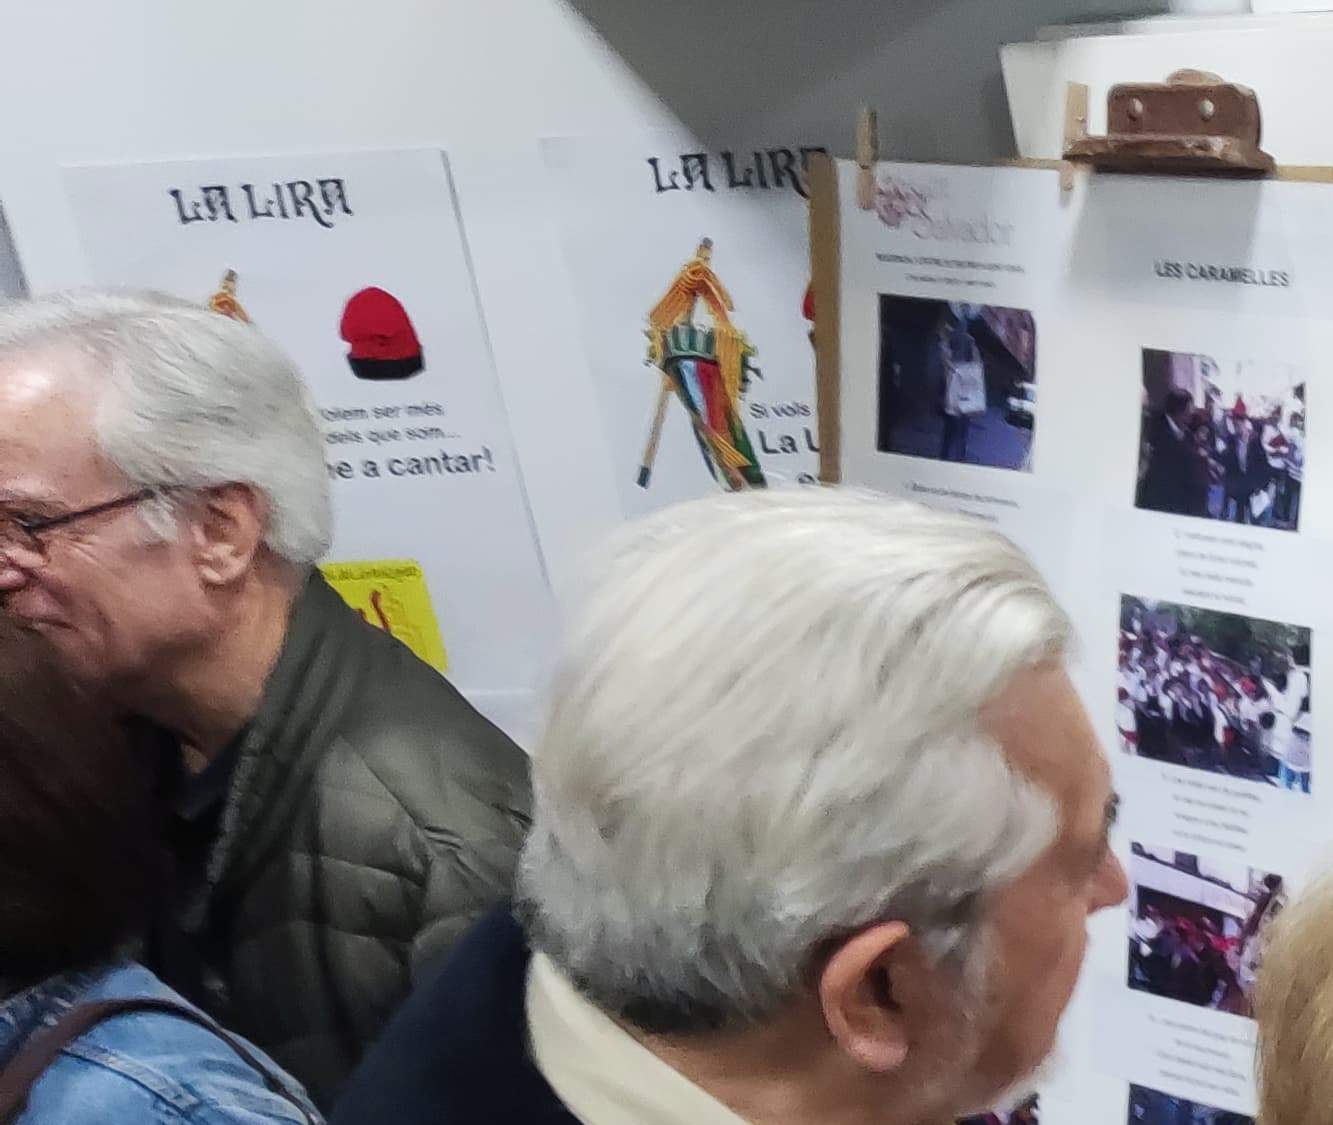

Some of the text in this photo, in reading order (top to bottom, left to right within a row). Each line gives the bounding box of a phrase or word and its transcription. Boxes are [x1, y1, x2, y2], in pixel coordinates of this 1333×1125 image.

[648, 153, 715, 192] LA
[169, 177, 354, 229] LA LIRA
[1155, 260, 1290, 288] LES CARAMELLES
[368, 428, 400, 446] que
[758, 429, 798, 455] La
[362, 457, 381, 478] a
[388, 446, 497, 477] cantar!
